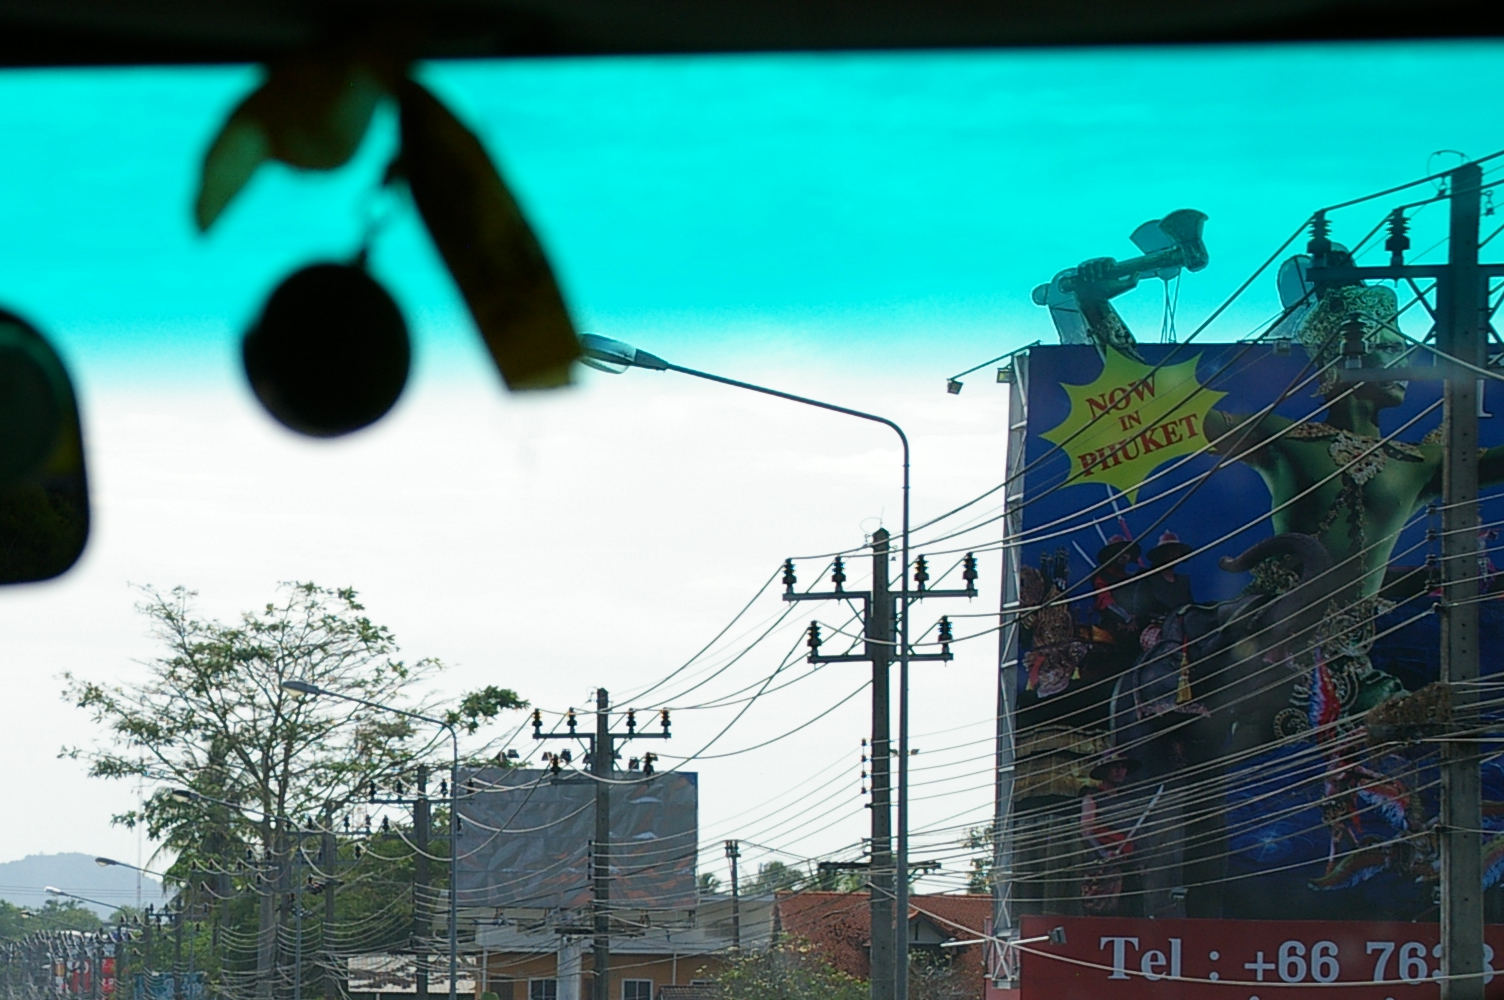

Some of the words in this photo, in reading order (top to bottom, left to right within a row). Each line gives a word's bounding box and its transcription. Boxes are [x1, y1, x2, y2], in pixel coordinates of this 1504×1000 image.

[1085, 373, 1156, 421] NOW
[1119, 410, 1142, 432] IN
[1077, 413, 1199, 477] PHUKET
[1100, 936, 1182, 981] Tel
[1244, 941, 1340, 984] +66
